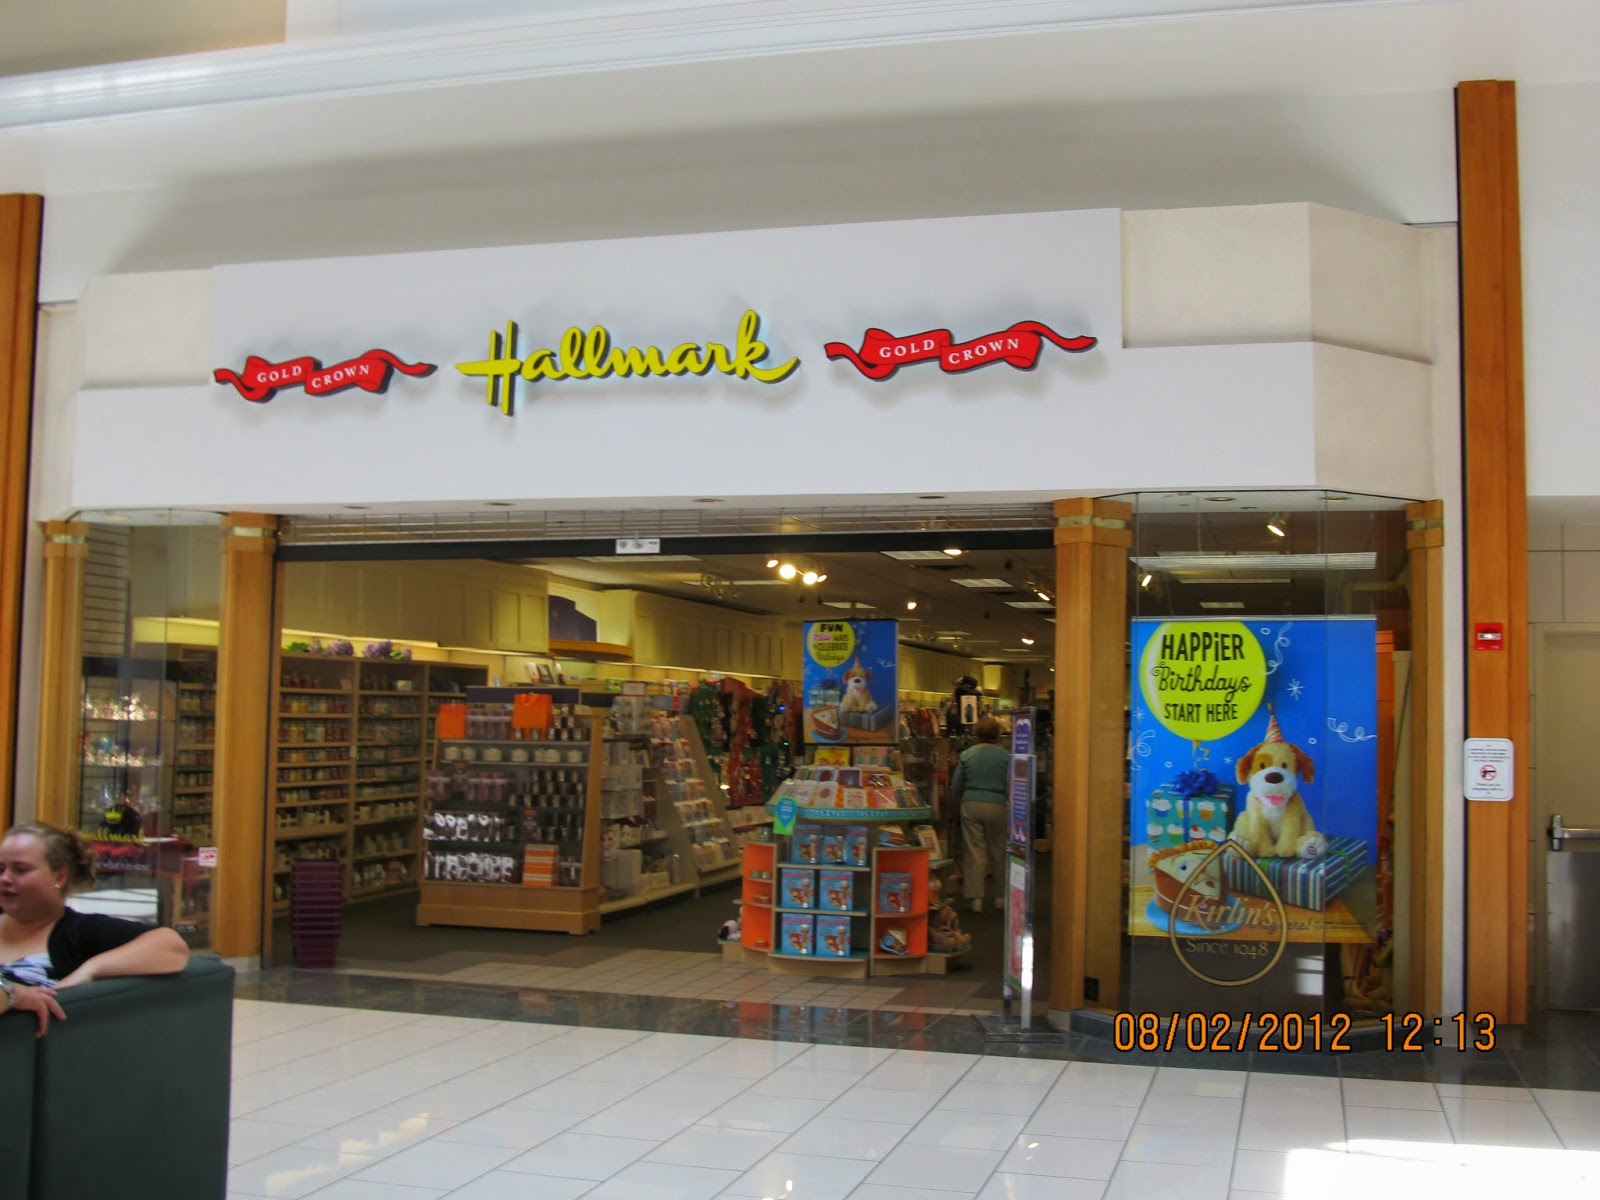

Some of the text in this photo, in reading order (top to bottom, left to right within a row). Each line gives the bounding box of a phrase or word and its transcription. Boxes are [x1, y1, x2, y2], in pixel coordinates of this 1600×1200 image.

[454, 309, 800, 415] Hallmark
[879, 338, 1020, 364] GOLD CROWN
[256, 365, 370, 389] GOLD CROWN
[820, 623, 844, 633] FUN
[1151, 661, 1252, 704] Birthdays
[1164, 703, 1238, 723] START HERE
[1183, 894, 1278, 934] Kirlin's
[1186, 938, 1228, 953] Since
